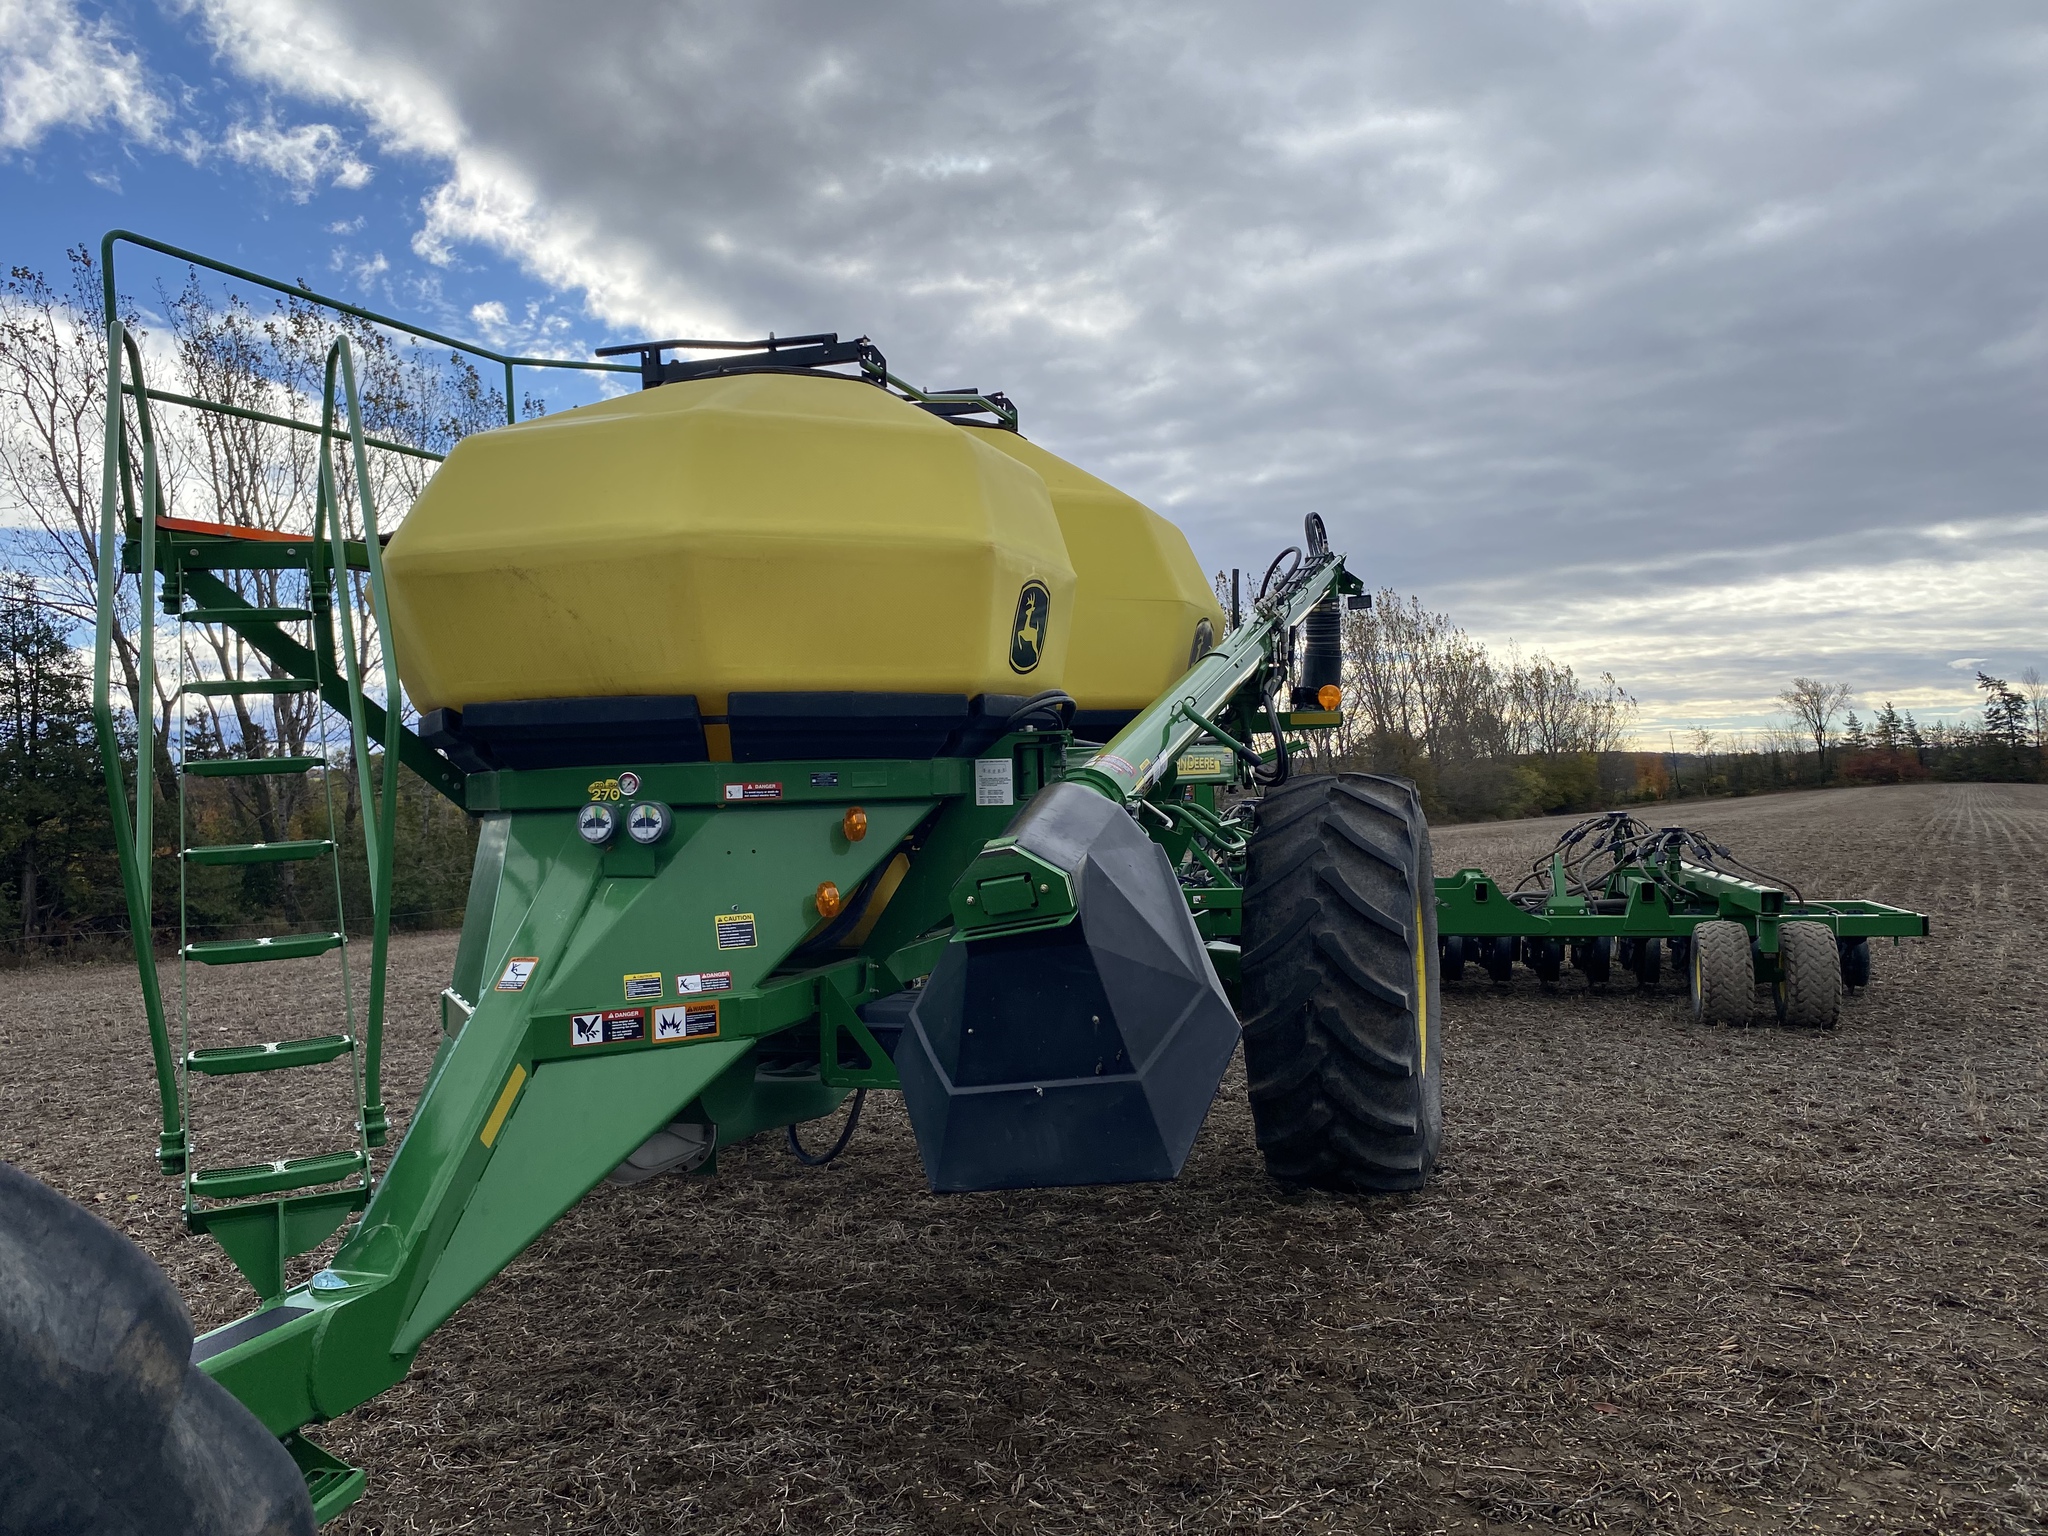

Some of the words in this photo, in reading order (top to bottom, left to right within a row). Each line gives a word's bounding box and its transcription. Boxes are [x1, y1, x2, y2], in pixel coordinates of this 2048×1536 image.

[1187, 755, 1215, 770] DEERE
[591, 788, 620, 801] 270
[723, 914, 752, 922] CAUTION
[693, 1004, 716, 1012] WARNING
[614, 1011, 639, 1019] DANGER
